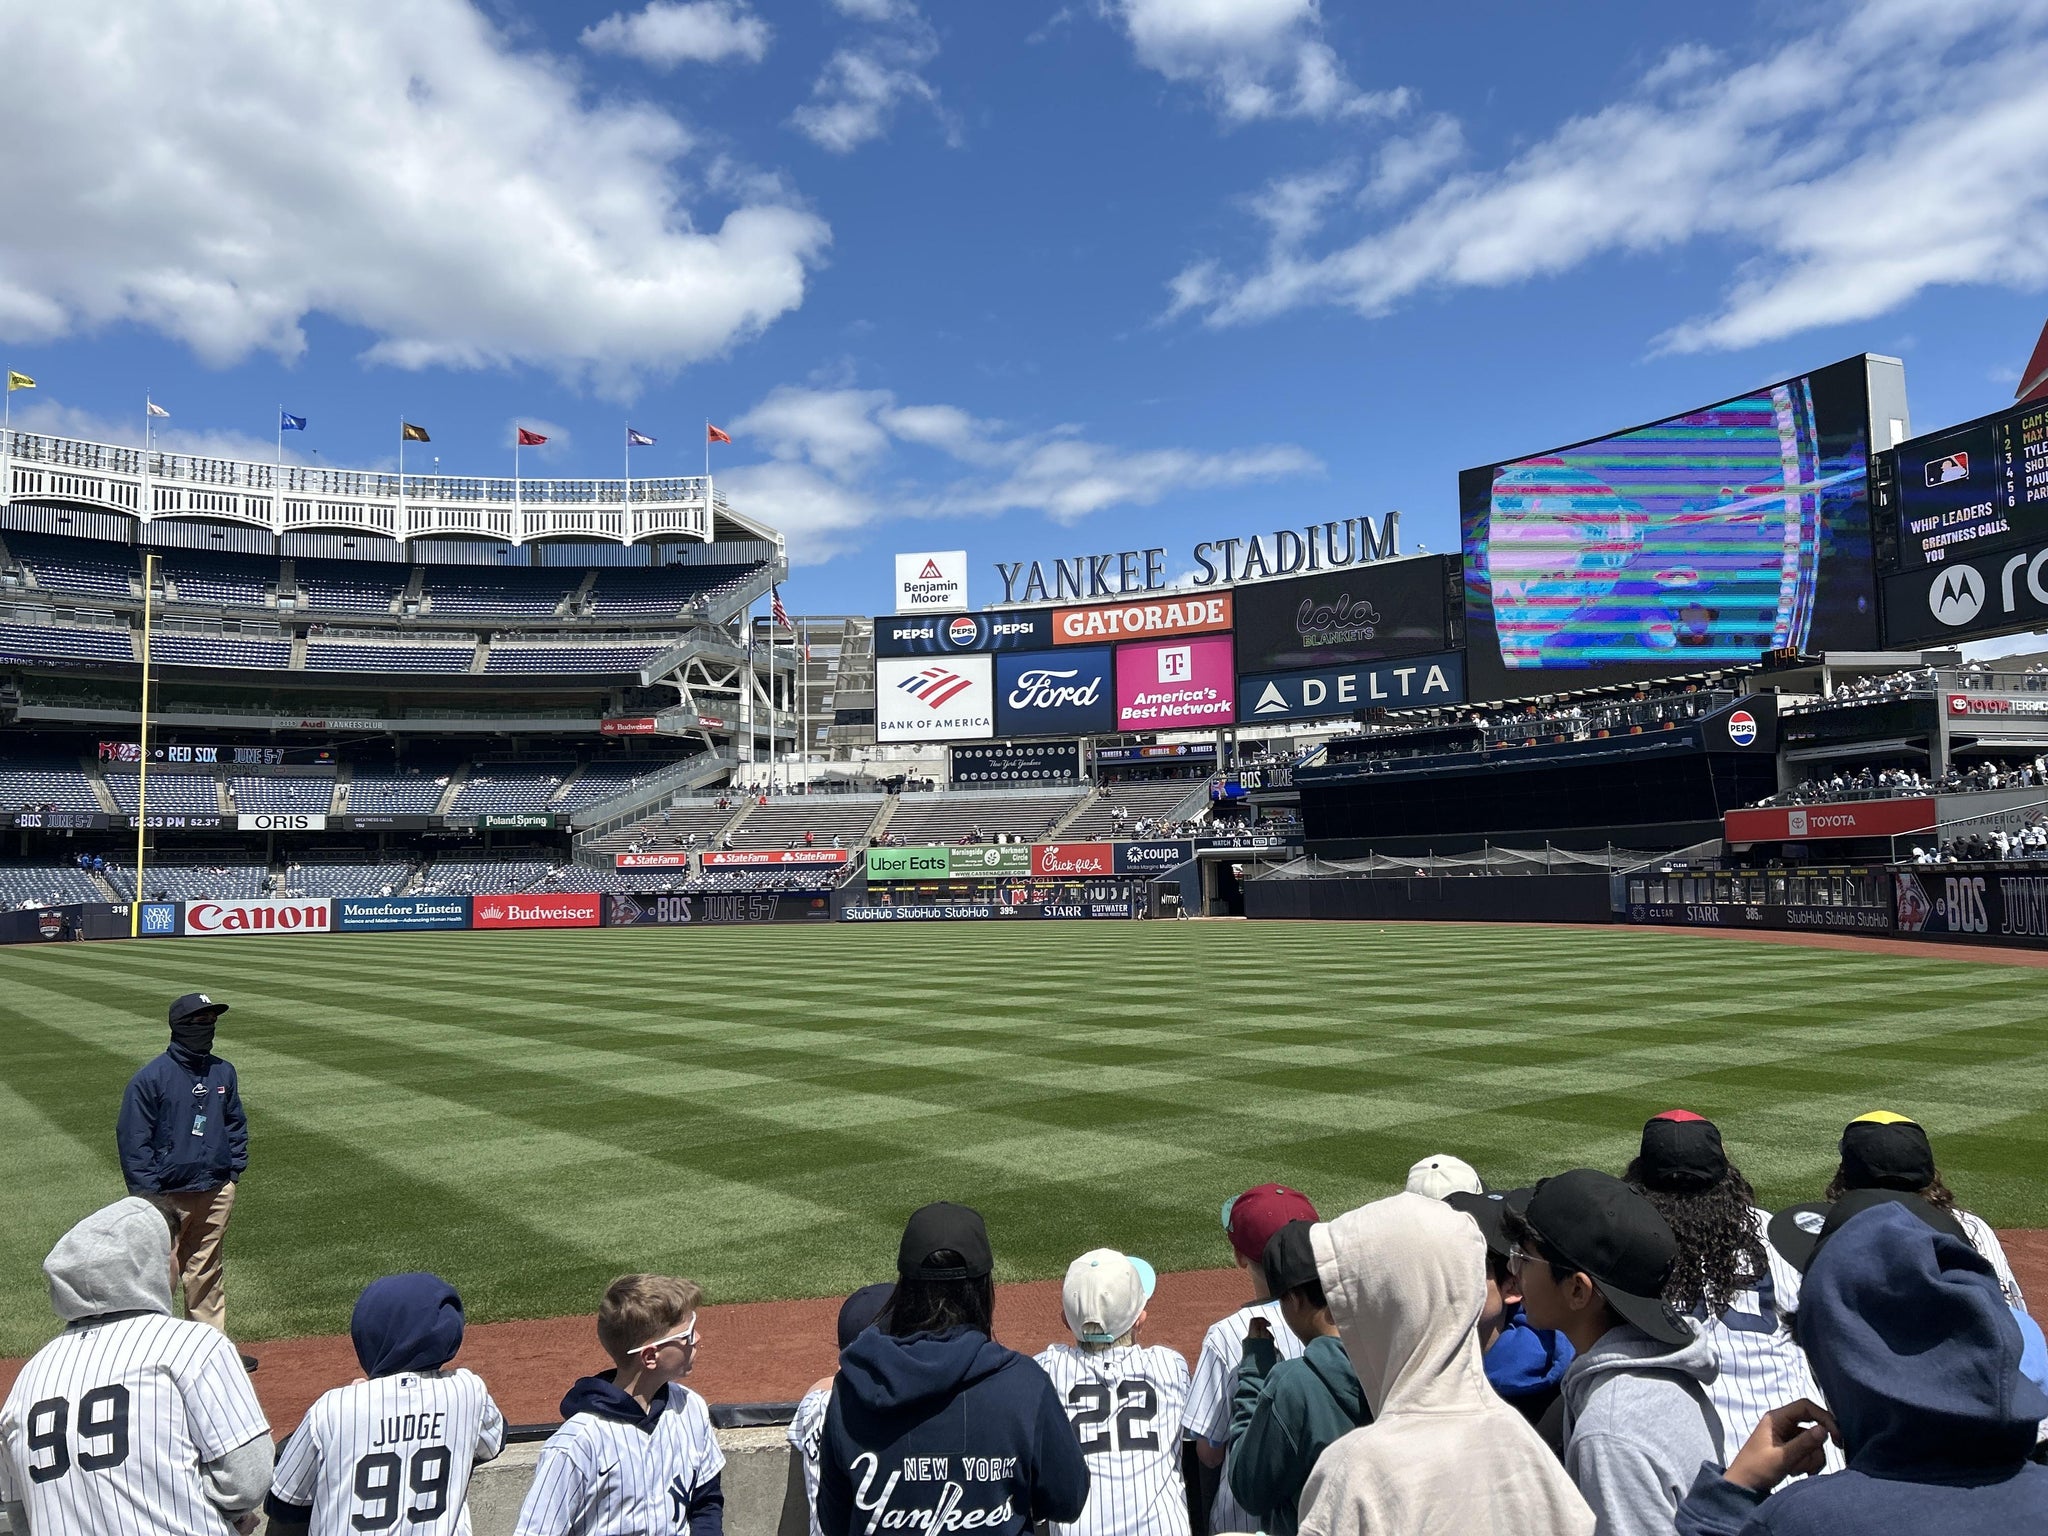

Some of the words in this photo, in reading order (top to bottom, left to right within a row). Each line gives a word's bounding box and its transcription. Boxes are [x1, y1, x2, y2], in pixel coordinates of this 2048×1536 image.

[2022, 413, 2042, 430] CAM
[2004, 439, 2011, 450] 2
[2023, 427, 2043, 444] MAX
[2005, 453, 2012, 464] 3
[2006, 467, 2014, 478] 4
[2007, 481, 2014, 493] 5
[2008, 496, 2015, 507] 6
[1910, 515, 1940, 534] WHIP
[1942, 501, 1993, 527] LEADERS
[1922, 526, 1977, 550] GREATNESS
[1978, 518, 2011, 537] CALLS,
[993, 547, 1168, 605] YANKEE
[1193, 511, 1402, 586] STADIUM
[1925, 548, 1945, 563] YOU
[904, 580, 958, 596] Benjamin
[911, 593, 949, 604] Moore
[1063, 598, 1225, 637] GATORADE
[893, 628, 934, 640] PEPSI
[951, 627, 976, 635] PEPSI
[993, 622, 1034, 635] PEPSI
[1303, 627, 1375, 647] BLANKETS
[1008, 669, 1102, 710] Ford
[1302, 664, 1450, 707] DELTA
[1133, 687, 1218, 706] America's
[1121, 703, 1157, 720] Best
[1159, 699, 1232, 717] Network
[1968, 699, 2010, 713] TOYOTA
[300, 720, 326, 728] Audi
[329, 720, 362, 729] YANKEES
[363, 721, 383, 729] CLUB
[617, 723, 653, 731] Budweiser
[880, 720, 914, 730] BANK
[917, 719, 932, 729] OF
[935, 717, 990, 729] AMERICA
[1730, 724, 1755, 733] PEPSI
[168, 746, 192, 762] RED
[194, 746, 218, 763] SOX
[233, 748, 262, 764] JUNE
[264, 748, 285, 764] 5-7
[1191, 745, 1213, 753] YANKEES
[208, 765, 260, 774] LANDING
[1240, 771, 1261, 789] BOS
[1267, 768, 1293, 788] JUNE
[20, 815, 41, 827] BOS
[48, 815, 73, 827] JUNE
[75, 815, 94, 827] 5-7
[166, 817, 186, 827] PM
[190, 818, 220, 827] 52.3°F
[255, 815, 309, 829] ORIS
[1810, 814, 1856, 828] TOYOTA
[951, 848, 984, 857] Morningside
[1143, 848, 1180, 862] coupa
[871, 857, 907, 871] Uber
[910, 856, 946, 870] Eats
[1042, 849, 1103, 873] Chick-fil-A
[112, 906, 129, 914] 318
[147, 907, 170, 915] NEW
[344, 904, 413, 916] Montefiore
[415, 903, 462, 915] Einstein
[657, 897, 692, 922] BOS
[702, 896, 744, 921] JUNE
[749, 895, 780, 921] 5-7
[999, 906, 1014, 915] 399
[1044, 905, 1082, 917] STARR
[1091, 904, 1128, 912] CUTWATER
[1945, 877, 1989, 933] BOS
[145, 913, 172, 923] YORK
[188, 903, 327, 931] Canon
[507, 905, 593, 921] Budweiser
[846, 908, 893, 920] StubHub
[896, 907, 941, 919] StubHub
[944, 906, 989, 918] StubHub
[1649, 908, 1674, 918] CLEAR
[1687, 905, 1720, 922] STARR
[1745, 907, 1759, 921] 385
[1787, 910, 1823, 925] StubHub
[1825, 911, 1856, 926] StubHub
[1857, 911, 1889, 928] StubHub
[147, 921, 169, 930] LIFE
[1069, 1380, 1160, 1454] 22
[27, 1383, 131, 1484] 99
[373, 1412, 445, 1447] JUDGE
[903, 1456, 949, 1482] NEW
[962, 1456, 1018, 1482] YORK
[351, 1445, 452, 1532] 99
[849, 1452, 1014, 1536] Yankees
